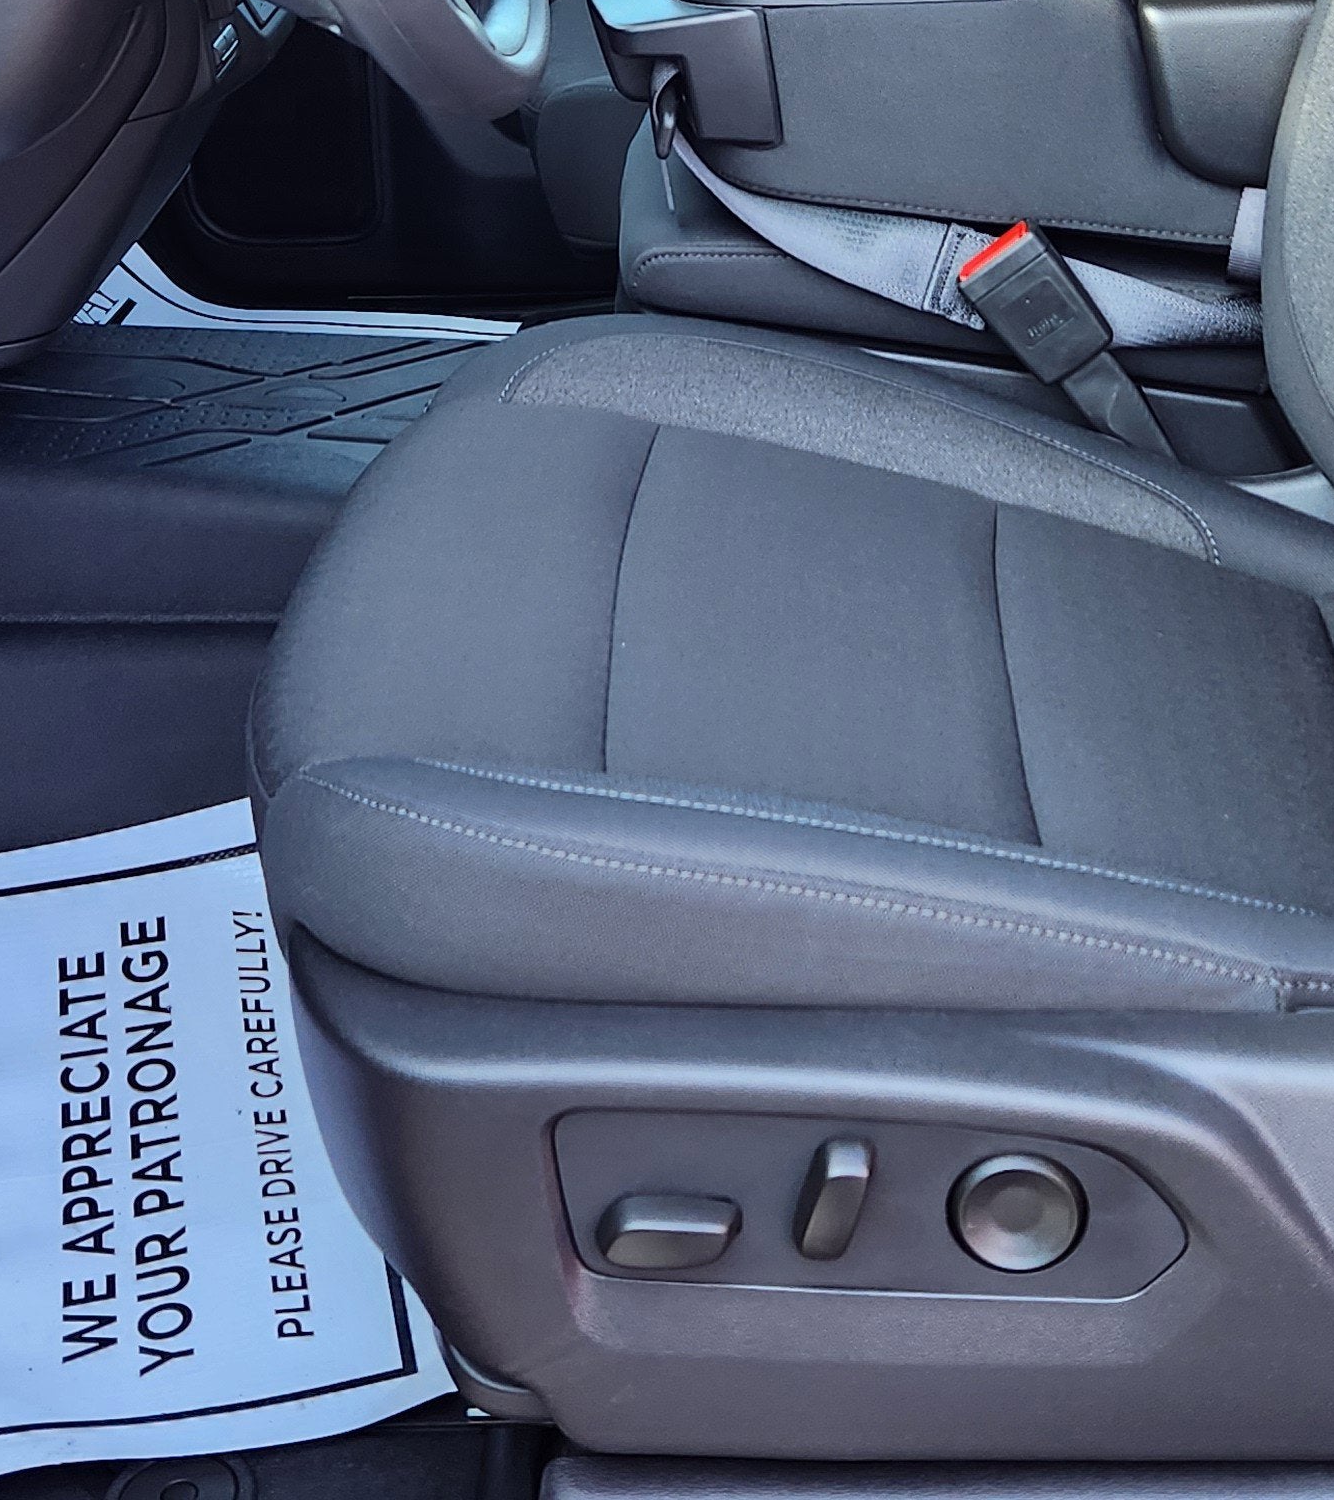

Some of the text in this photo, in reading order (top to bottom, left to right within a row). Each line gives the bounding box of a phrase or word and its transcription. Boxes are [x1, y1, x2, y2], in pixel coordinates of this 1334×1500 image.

[58, 951, 118, 1364] WE APPRECIATE
[119, 916, 195, 1377] YOUR PATRONAGE
[231, 910, 315, 1339] PLEASE DRIVE CAREFULLY!
